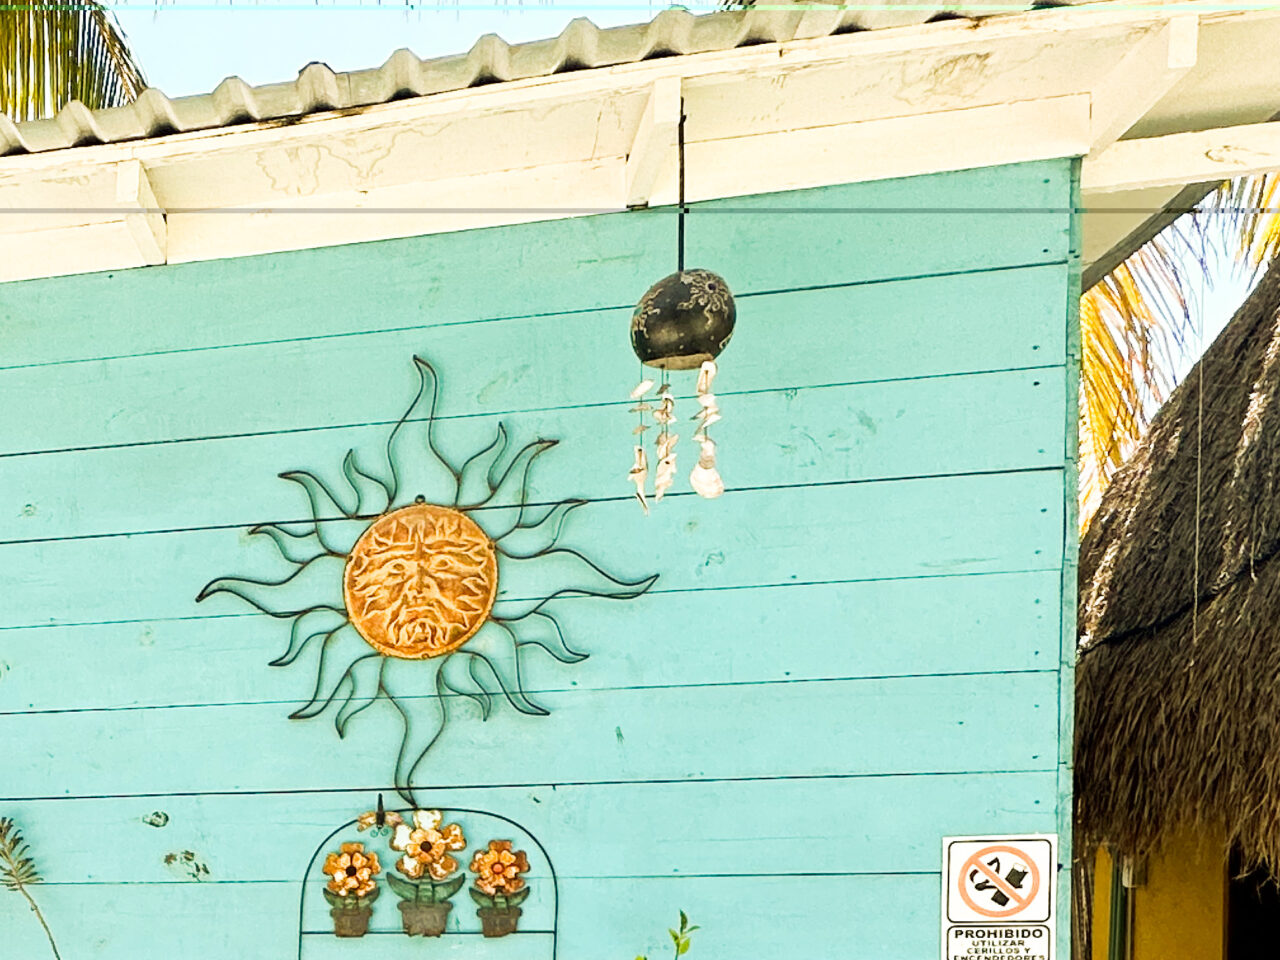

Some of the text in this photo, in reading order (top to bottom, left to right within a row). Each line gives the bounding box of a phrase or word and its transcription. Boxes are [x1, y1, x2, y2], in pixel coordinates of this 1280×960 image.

[954, 928, 1043, 939] PROHIBIDO
[971, 939, 1025, 947] UTILIZAR
[966, 947, 1020, 955] CERILLOS
